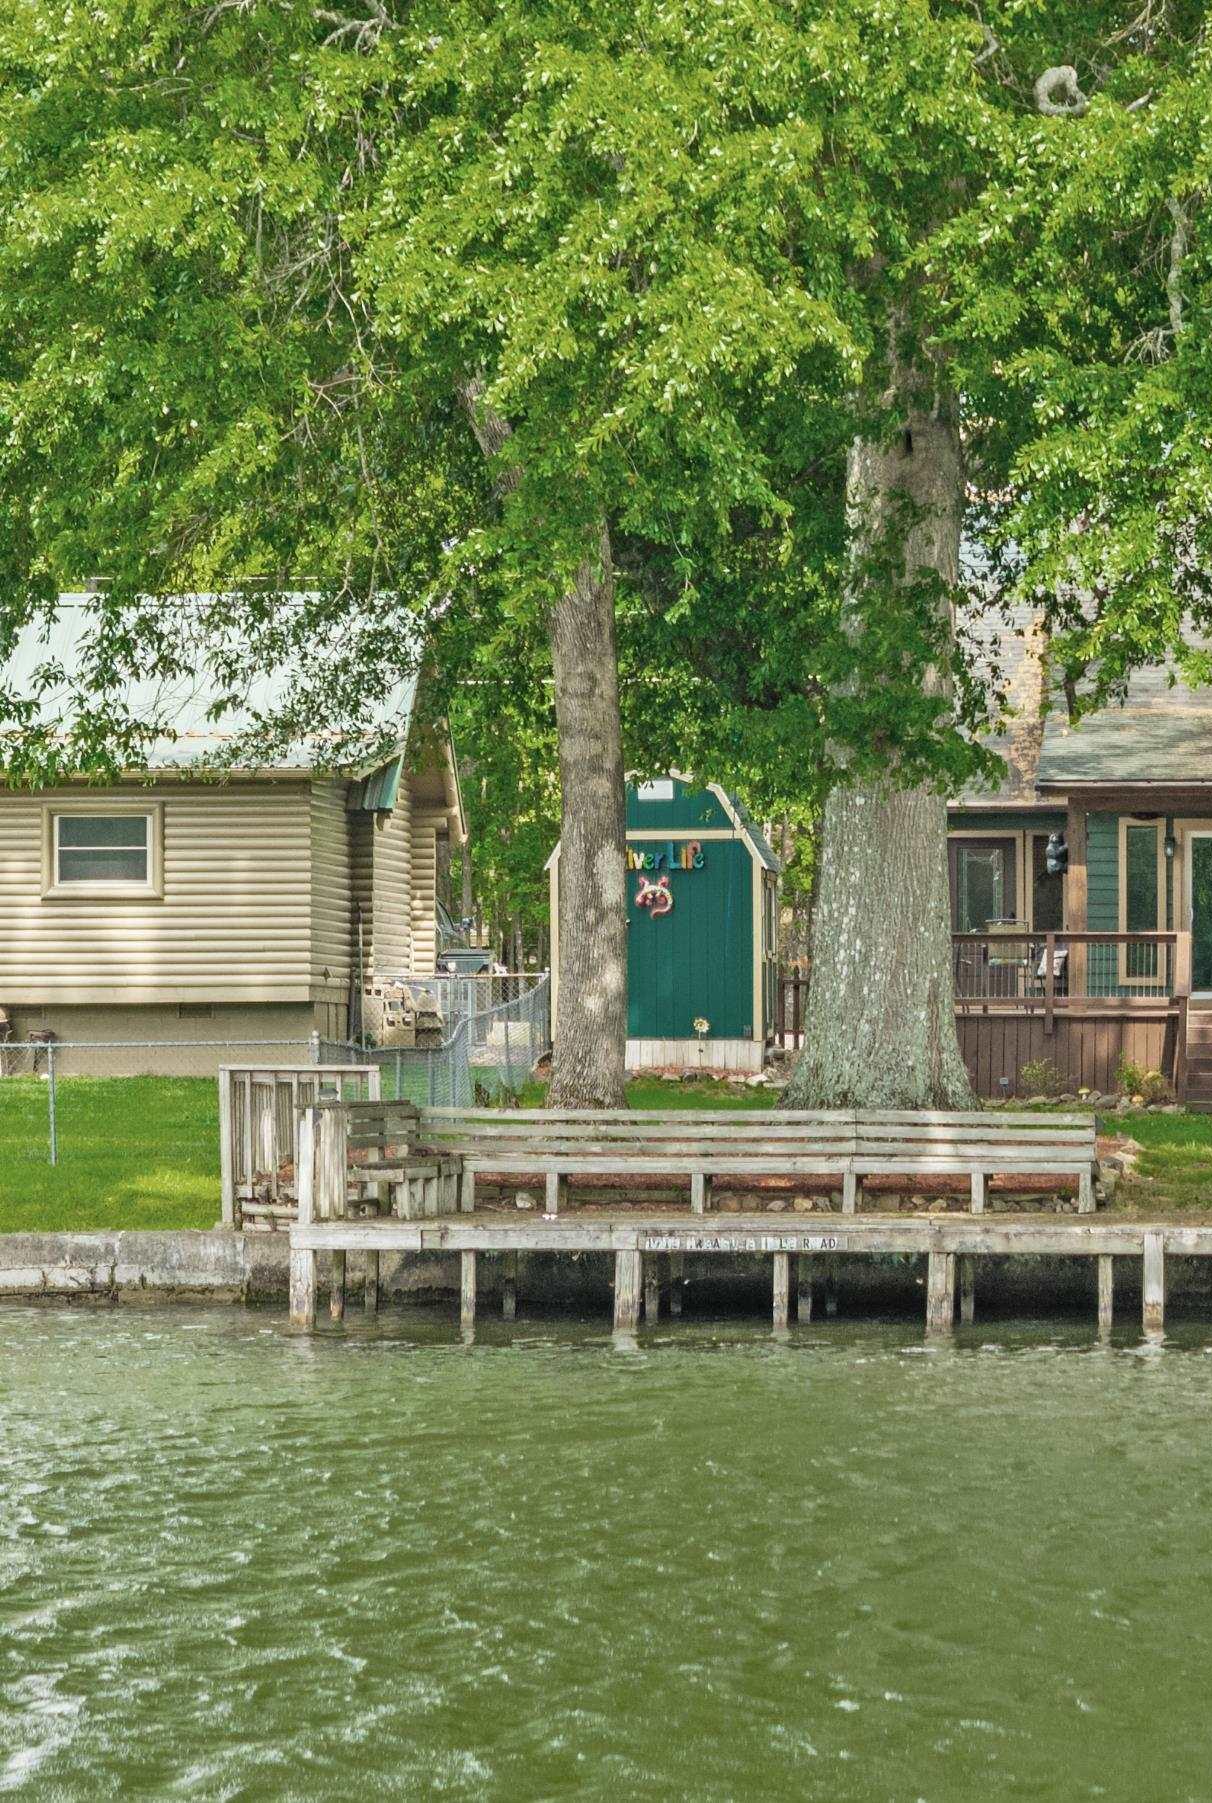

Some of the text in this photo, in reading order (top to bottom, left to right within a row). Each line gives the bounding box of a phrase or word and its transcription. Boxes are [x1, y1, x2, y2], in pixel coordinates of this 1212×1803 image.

[626, 840, 705, 869] iver Life
[802, 1238, 837, 1249] RAD
